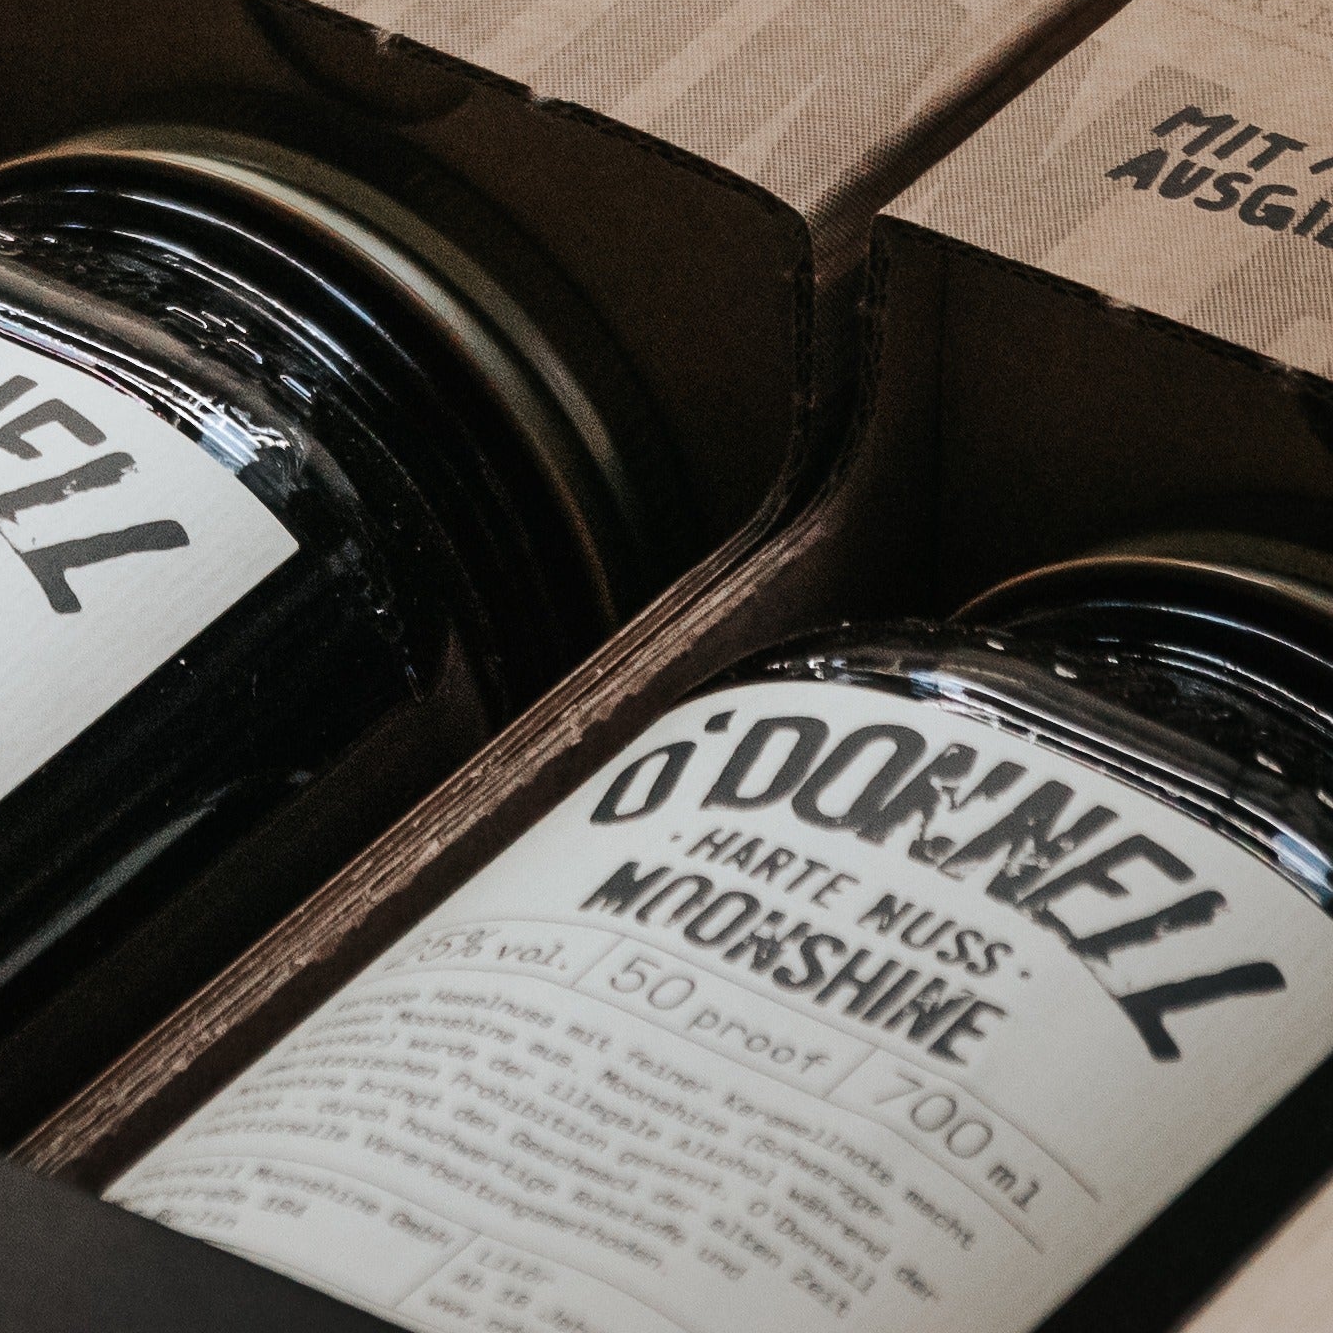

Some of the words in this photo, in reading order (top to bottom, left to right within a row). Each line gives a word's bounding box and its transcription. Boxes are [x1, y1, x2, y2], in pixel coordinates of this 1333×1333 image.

[1103, 146, 1333, 250] AUSGI
[1150, 104, 1310, 173] MIT
[588, 707, 1288, 1065] O'DONNELL
[685, 826, 860, 909] HARTE
[856, 892, 1015, 982] NUSS
[494, 938, 569, 972] vol.
[576, 858, 1012, 1068] MOONSHINE
[606, 951, 699, 1013] 50
[687, 1009, 833, 1076] proof
[871, 1066, 996, 1161] 700
[985, 1160, 1043, 1215] ml
